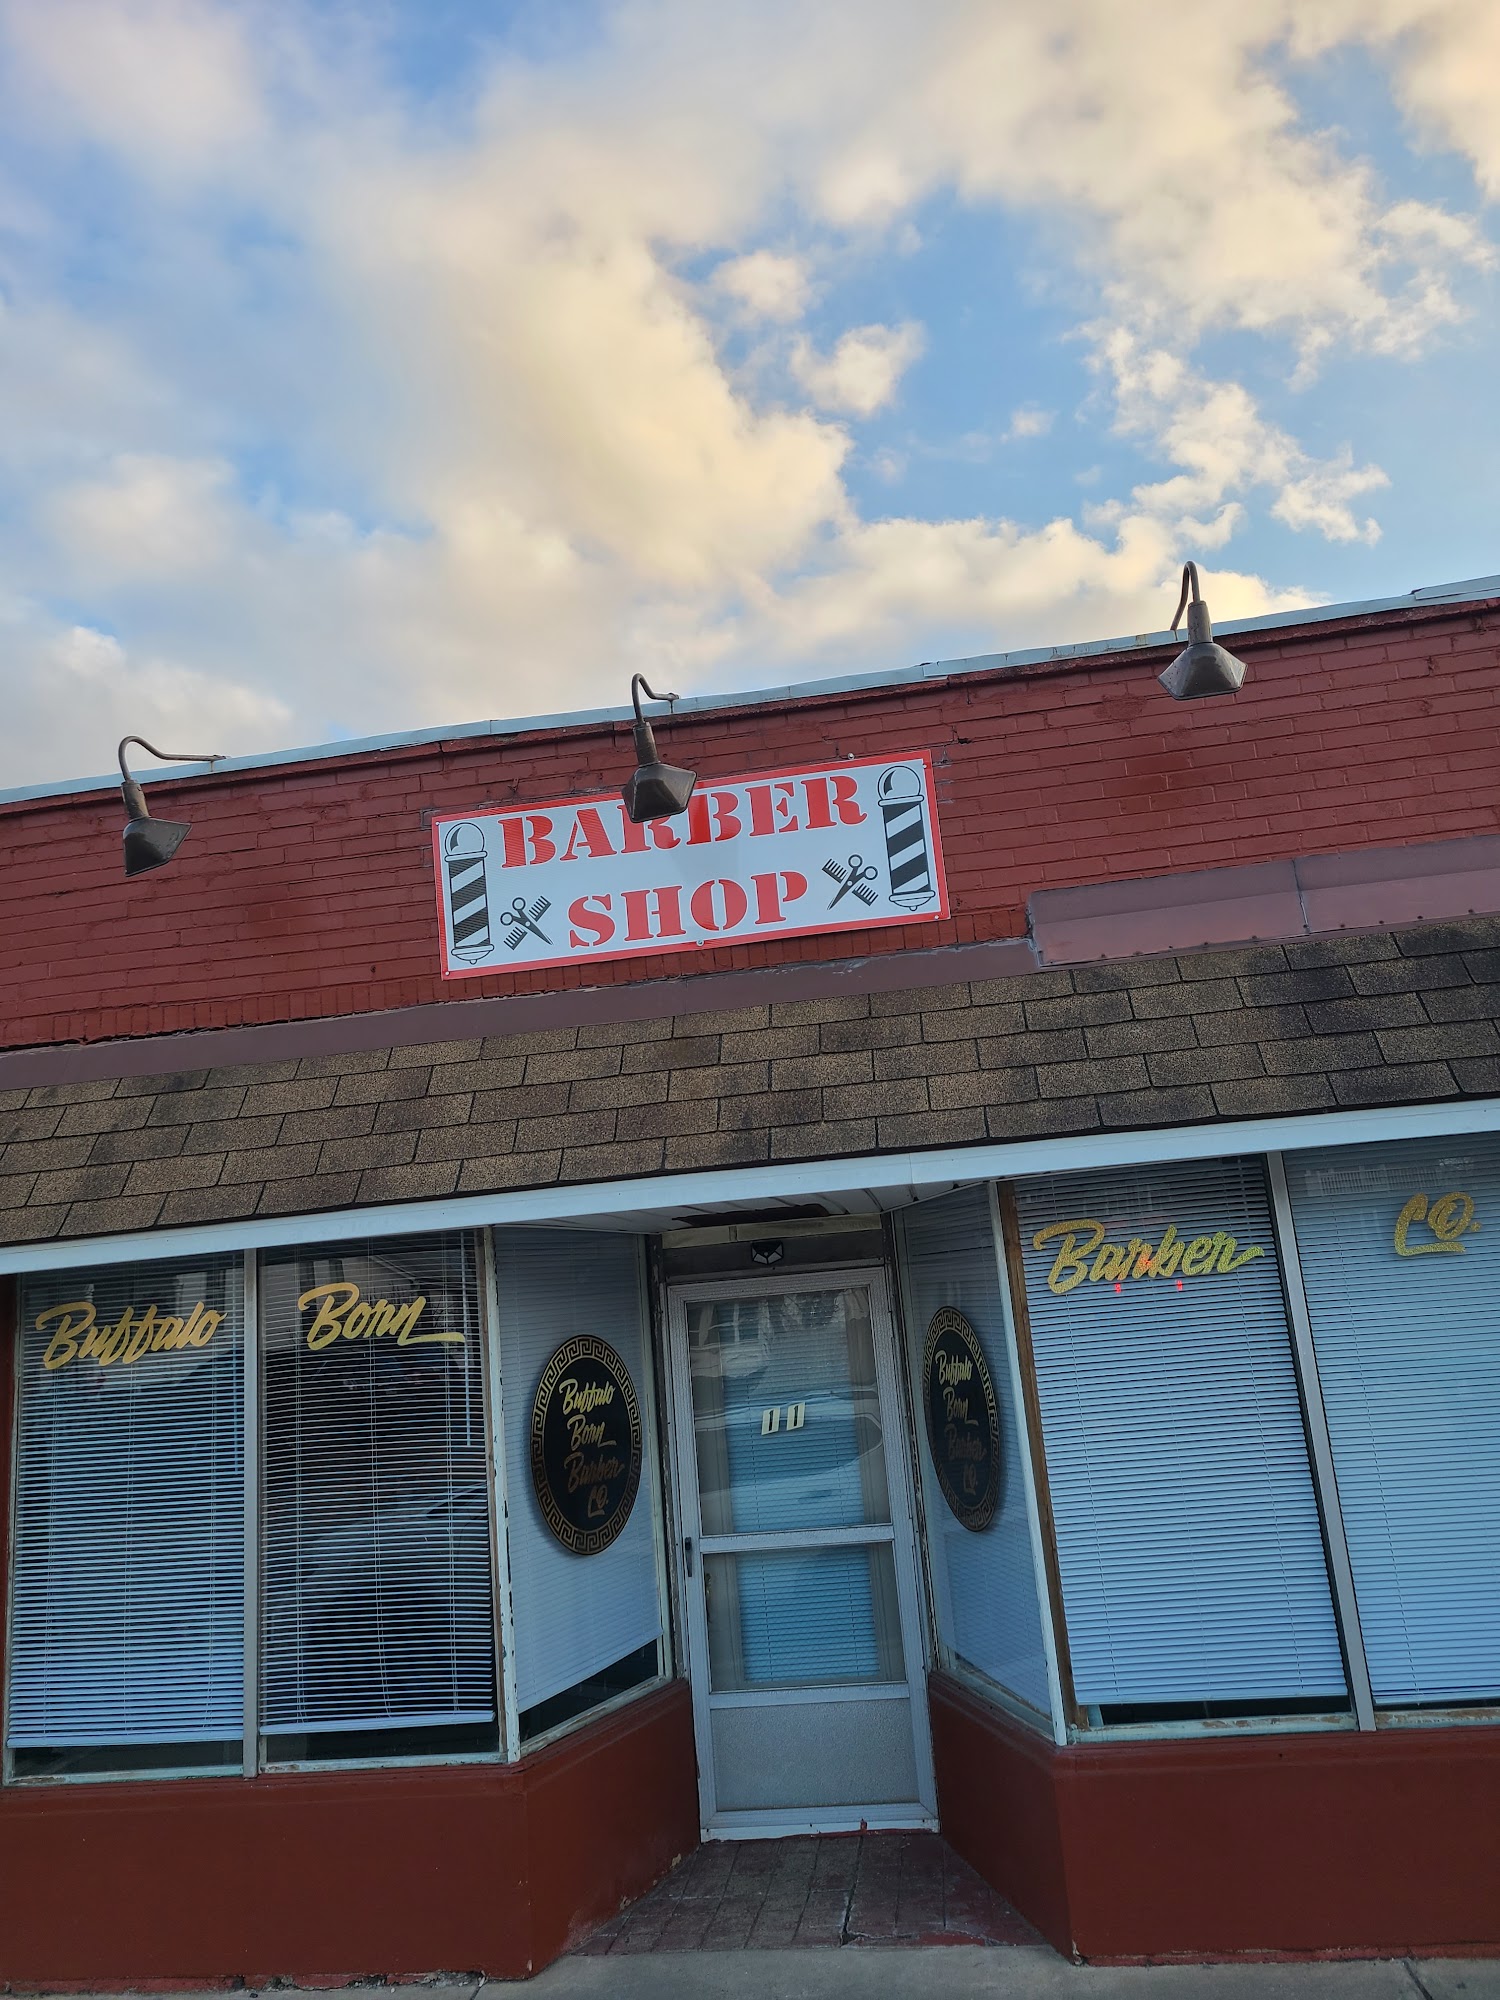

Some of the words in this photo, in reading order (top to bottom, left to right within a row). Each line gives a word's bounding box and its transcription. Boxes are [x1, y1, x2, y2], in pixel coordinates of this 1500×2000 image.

[498, 775, 867, 868] BARBER
[568, 871, 808, 949] SHOP
[1033, 1219, 1265, 1294] Barber
[35, 1301, 227, 1370] Buffalo
[298, 1282, 465, 1350] Born
[935, 1350, 973, 1386] Buffalo
[559, 1378, 616, 1415] Buffalo
[943, 1387, 979, 1426] Born
[567, 1414, 617, 1451] Born
[766, 1403, 801, 1433] 11
[944, 1424, 987, 1461] Barber
[564, 1452, 625, 1493] Barber
